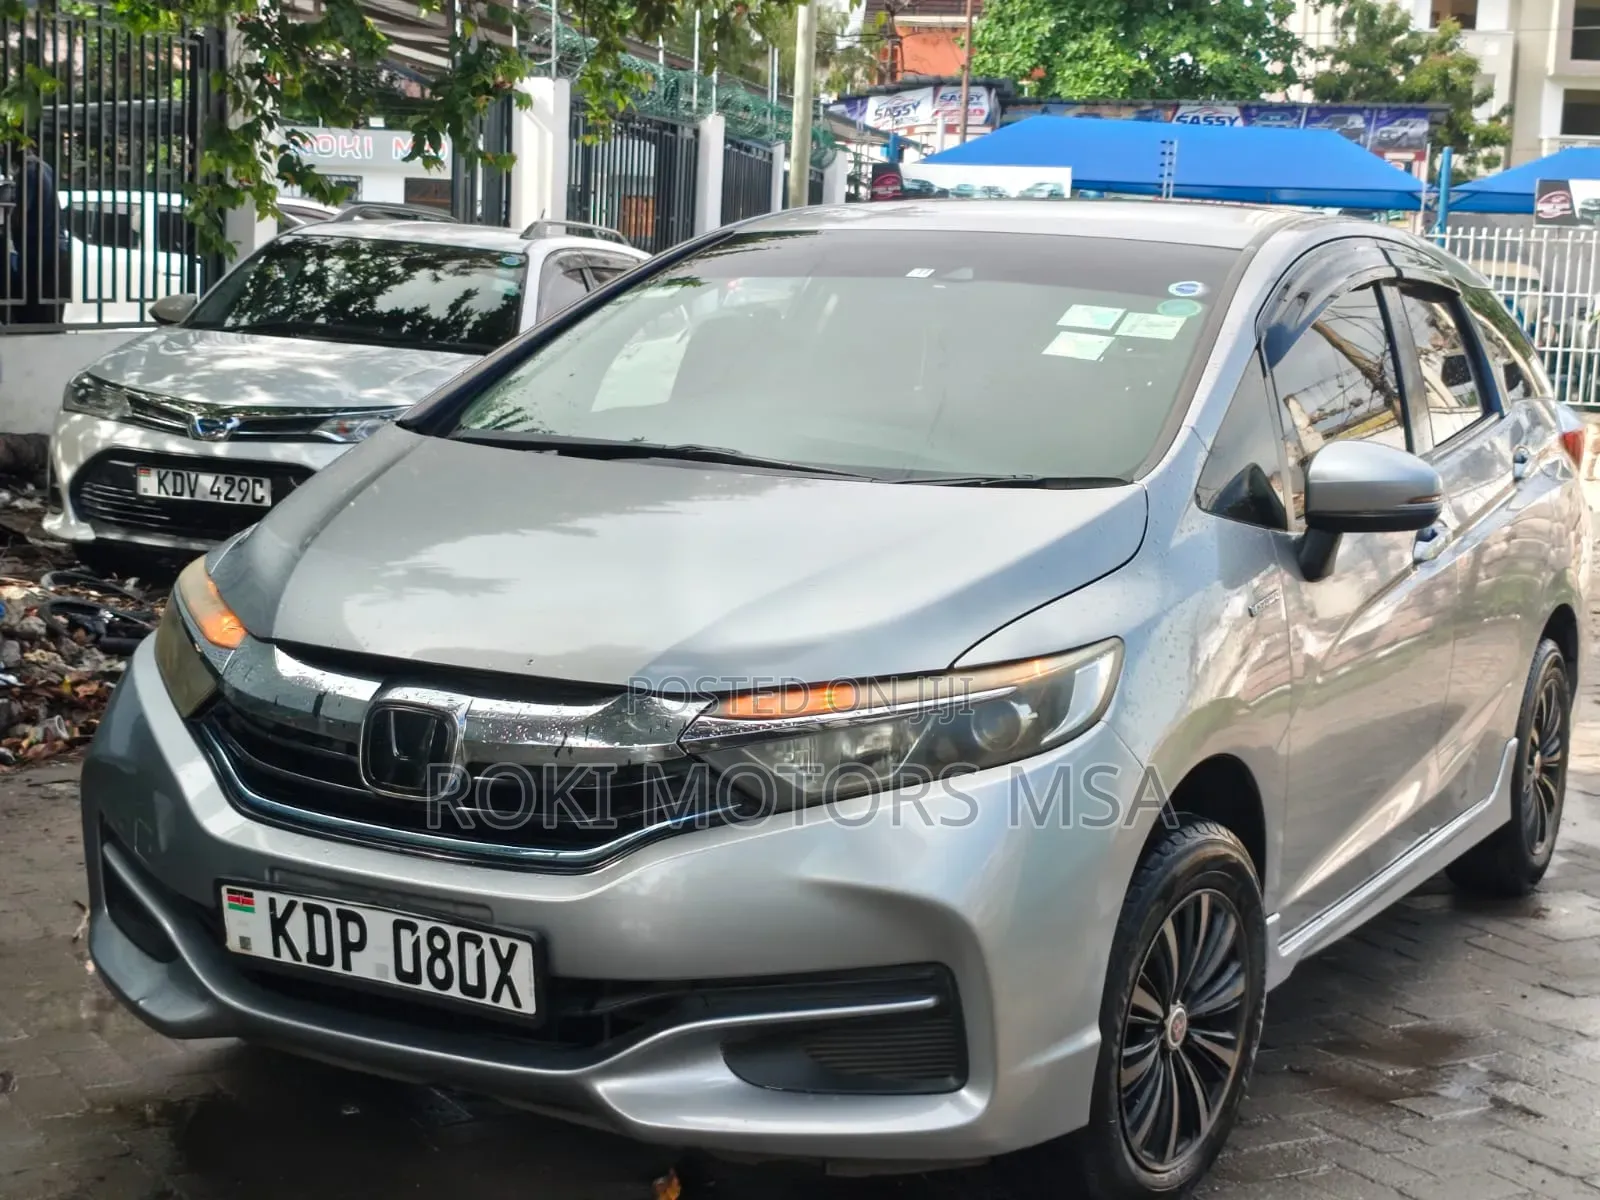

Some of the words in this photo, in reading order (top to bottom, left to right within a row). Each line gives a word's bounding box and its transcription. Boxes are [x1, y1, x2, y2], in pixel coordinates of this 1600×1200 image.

[873, 100, 921, 121] SASSY
[1175, 115, 1241, 127] SASSY
[157, 470, 199, 498] KDV
[209, 475, 265, 504] 429C
[268, 897, 368, 972] KDP
[392, 918, 522, 1009] 080X
